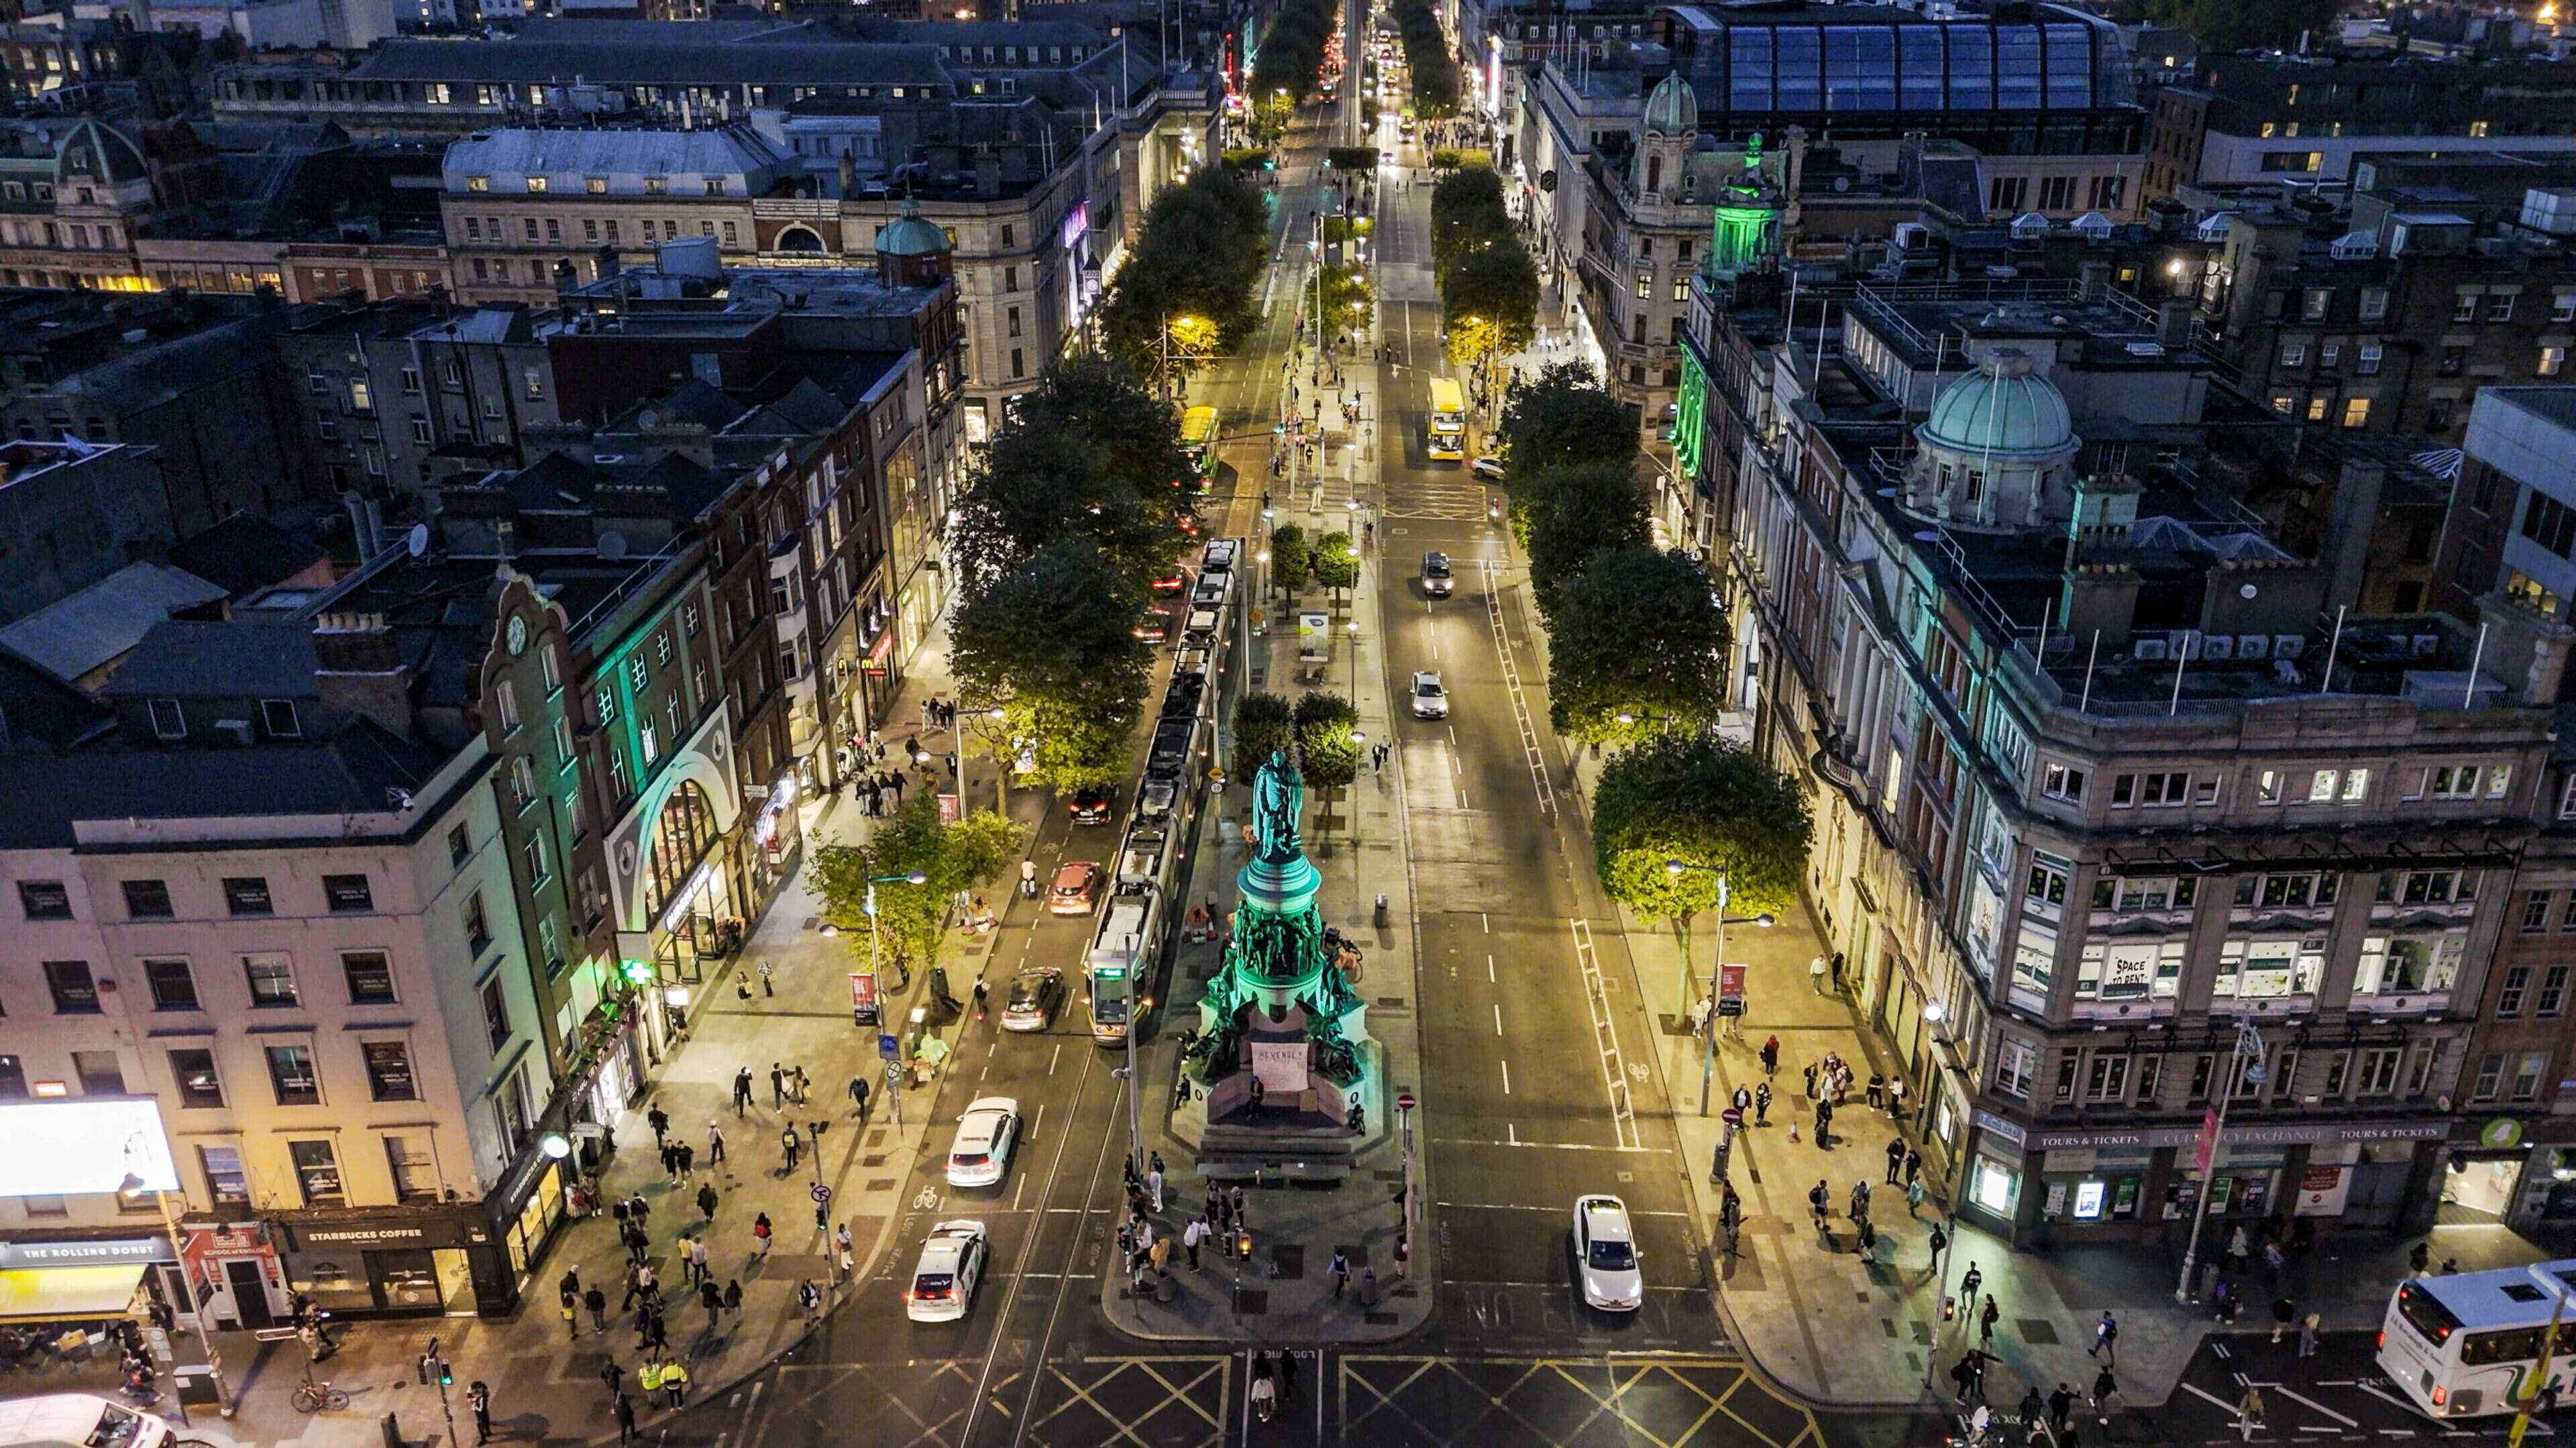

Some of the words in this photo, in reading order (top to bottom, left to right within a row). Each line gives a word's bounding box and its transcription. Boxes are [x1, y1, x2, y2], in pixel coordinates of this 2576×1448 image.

[2116, 959, 2145, 974] SPACE
[2245, 1130, 2324, 1141] EXCHANGE
[2341, 1129, 2378, 1139] TOURS
[2379, 1129, 2388, 1137] &
[2392, 1128, 2437, 1137] TICKETS
[2041, 1137, 2079, 1147] TOURS
[2081, 1137, 2090, 1146] &
[2092, 1135, 2140, 1146] TICKETS
[309, 1230, 377, 1241] STARBUCKS
[378, 1229, 422, 1239] COFFEE
[23, 1249, 48, 1258] THE
[52, 1247, 107, 1258] ROLLING
[111, 1246, 154, 1256] DONUT
